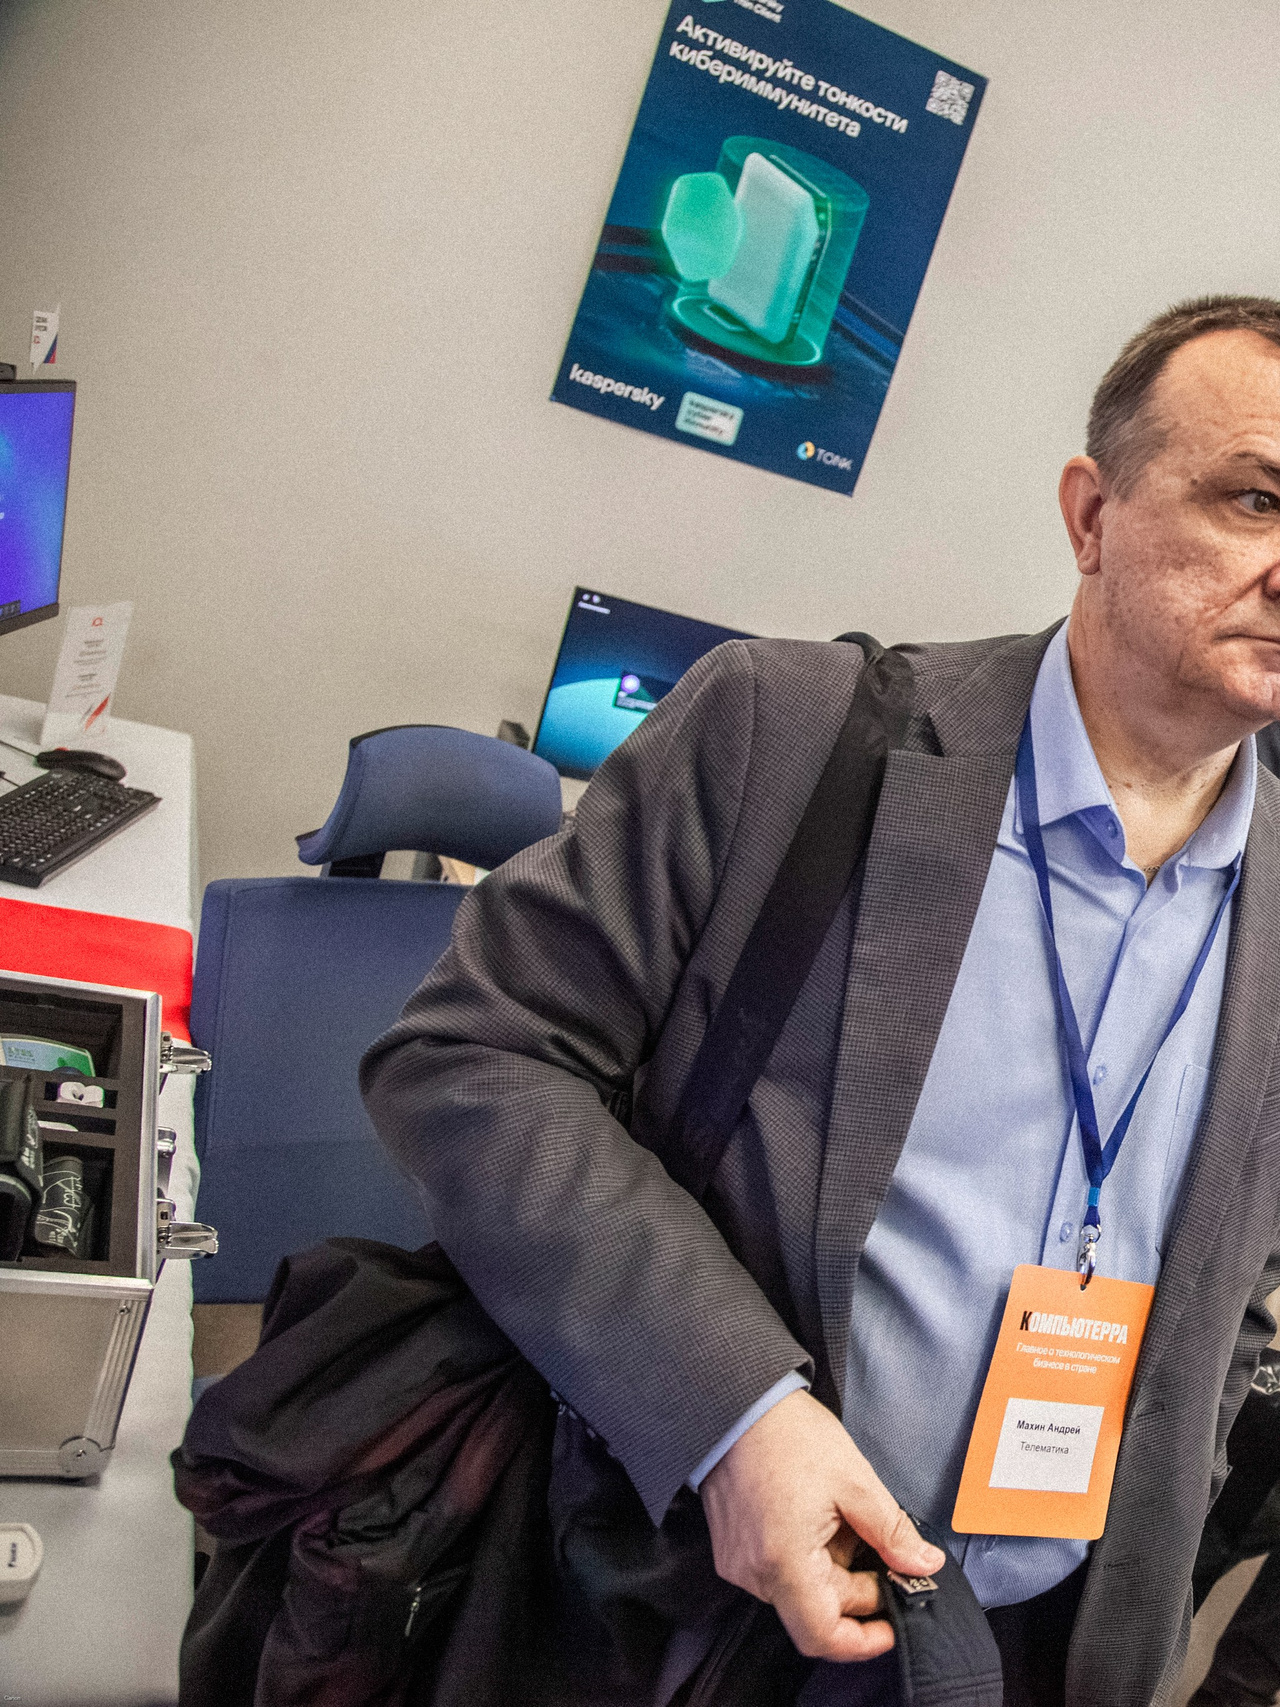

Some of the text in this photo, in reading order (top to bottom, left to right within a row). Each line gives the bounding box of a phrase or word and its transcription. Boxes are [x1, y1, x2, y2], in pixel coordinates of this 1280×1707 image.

[676, 14, 909, 134] Активируйте тонкости
[669, 40, 861, 138] кибериммунитета
[569, 363, 665, 411] kaspersky
[1019, 1310, 1128, 1345] КОМПЬЮТЕРРА
[1016, 1342, 1048, 1356] Главное
[1055, 1348, 1121, 1364] технологическом
[1033, 1358, 1064, 1371] бизнесе
[1070, 1364, 1097, 1374] стране
[1016, 1419, 1081, 1435] Махин Андрей
[1020, 1441, 1070, 1455] Телематика
